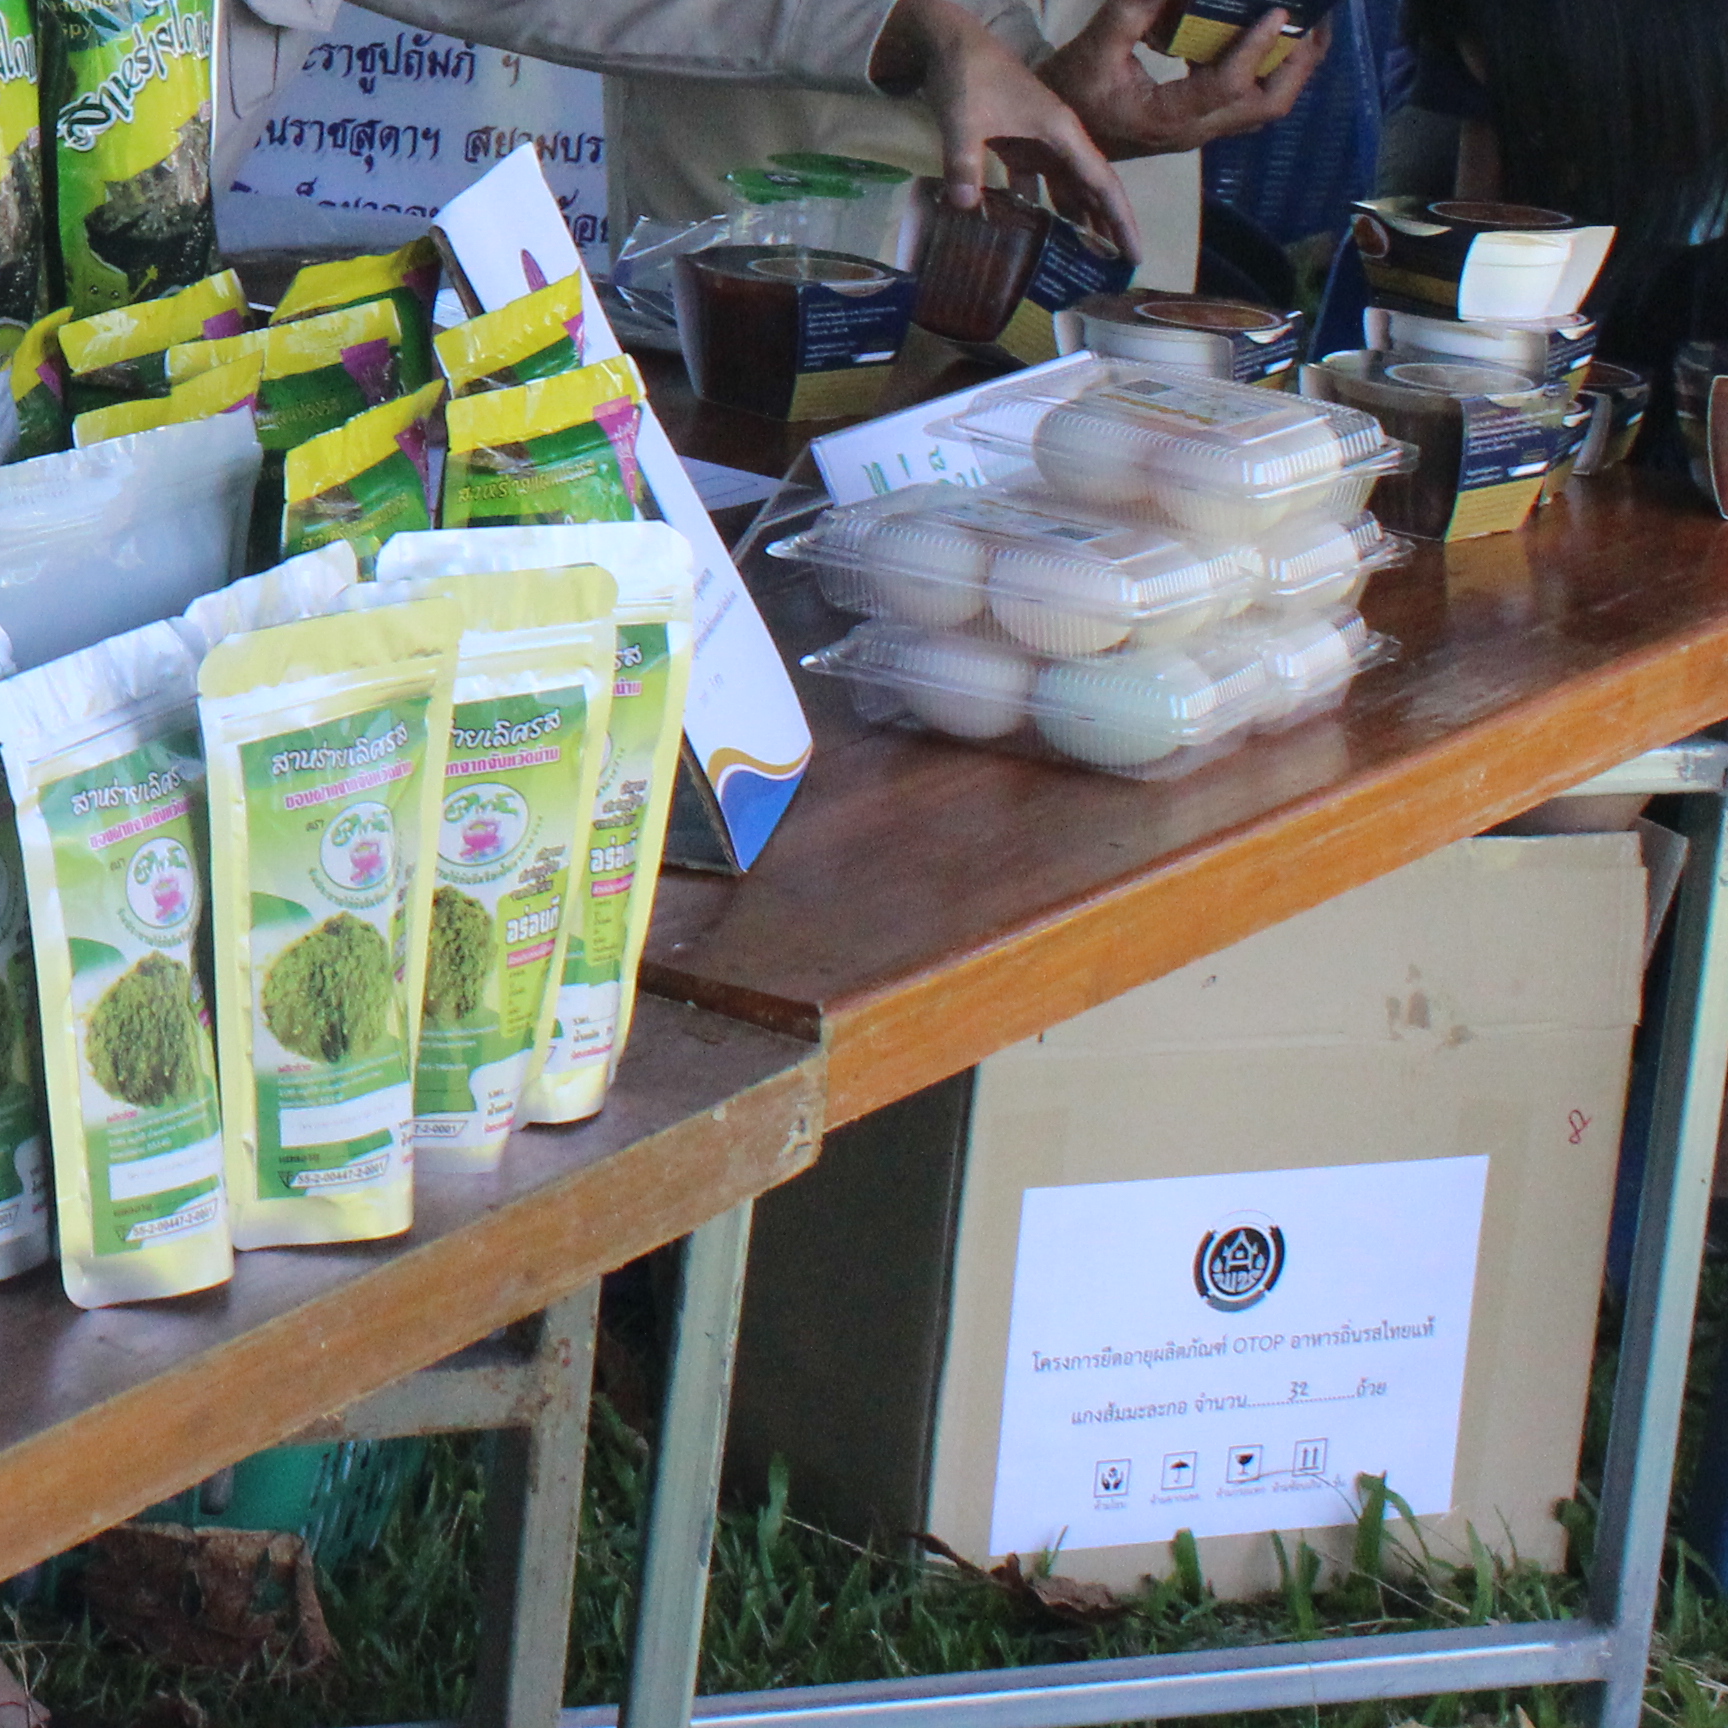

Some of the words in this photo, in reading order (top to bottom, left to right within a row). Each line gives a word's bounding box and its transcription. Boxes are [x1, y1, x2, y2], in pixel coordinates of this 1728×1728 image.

[1233, 1334, 1285, 1355] OTOP
[1070, 1398, 1187, 1426] แกงส้มมะละกอ
